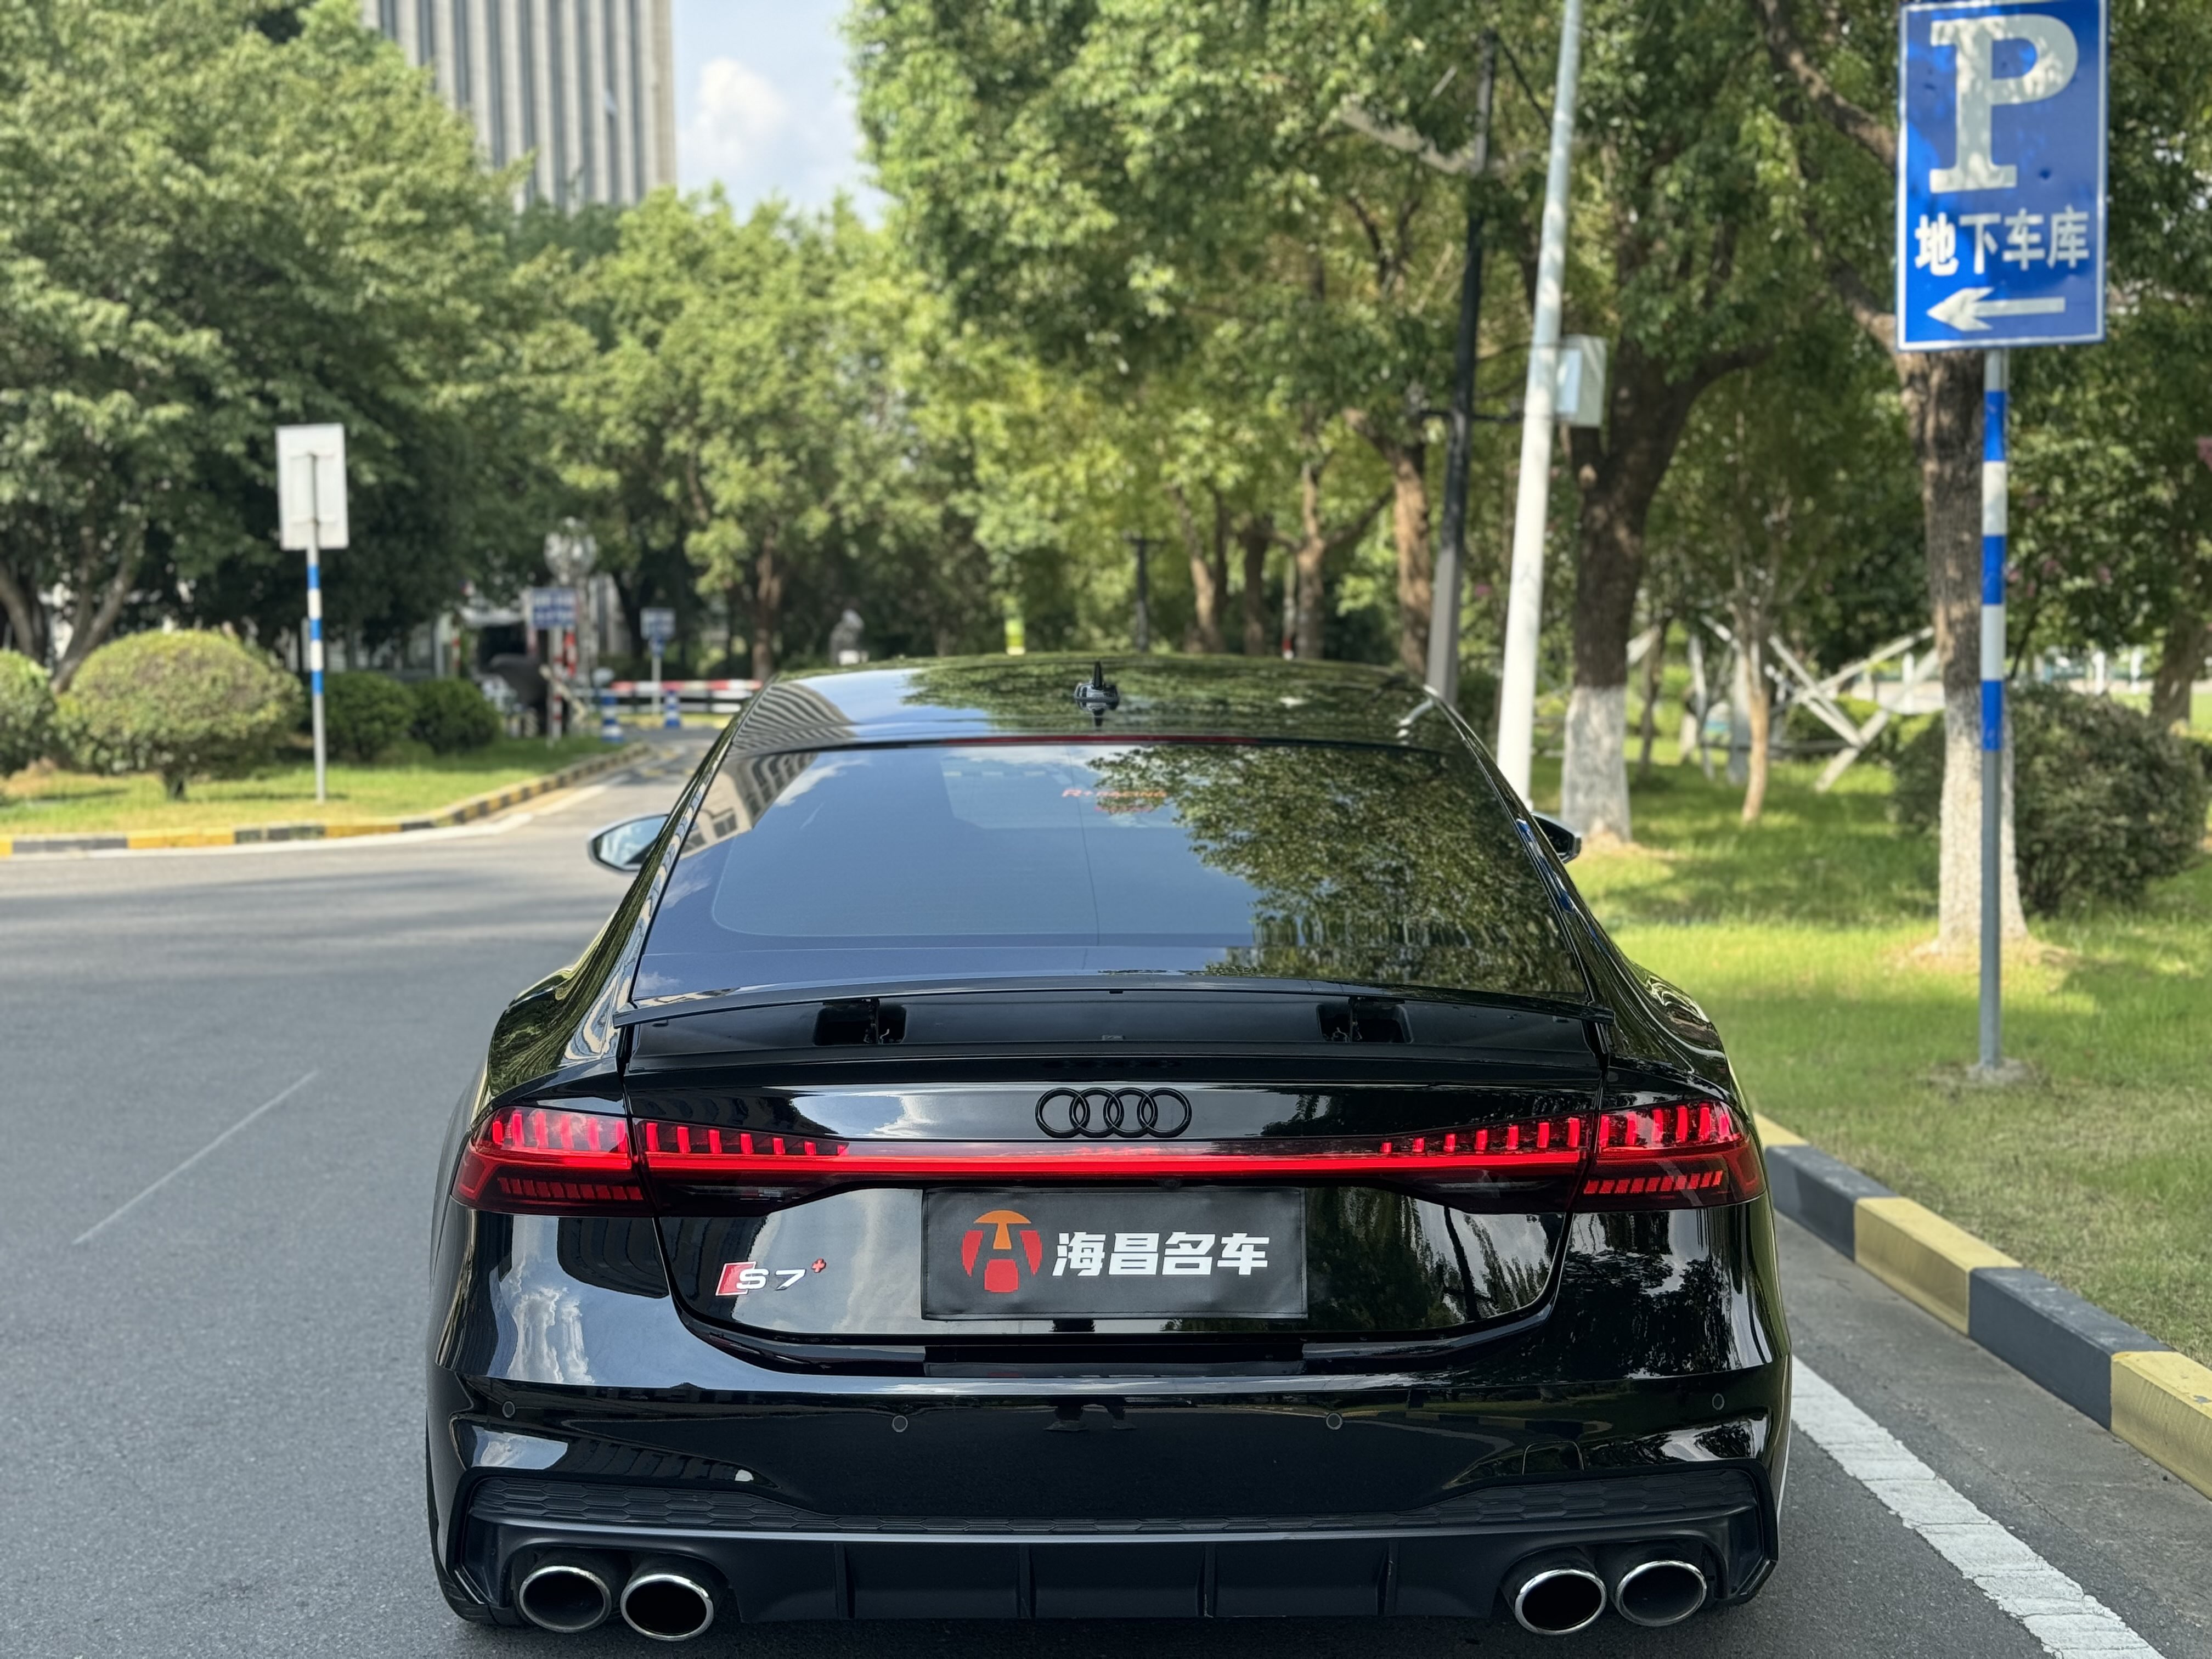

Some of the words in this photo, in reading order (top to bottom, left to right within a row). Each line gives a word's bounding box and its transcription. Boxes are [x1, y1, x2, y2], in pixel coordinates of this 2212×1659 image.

[1929, 14, 2079, 194] P
[1915, 205, 2090, 276] 地下车库
[1052, 1231, 1270, 1277] 海昌名车
